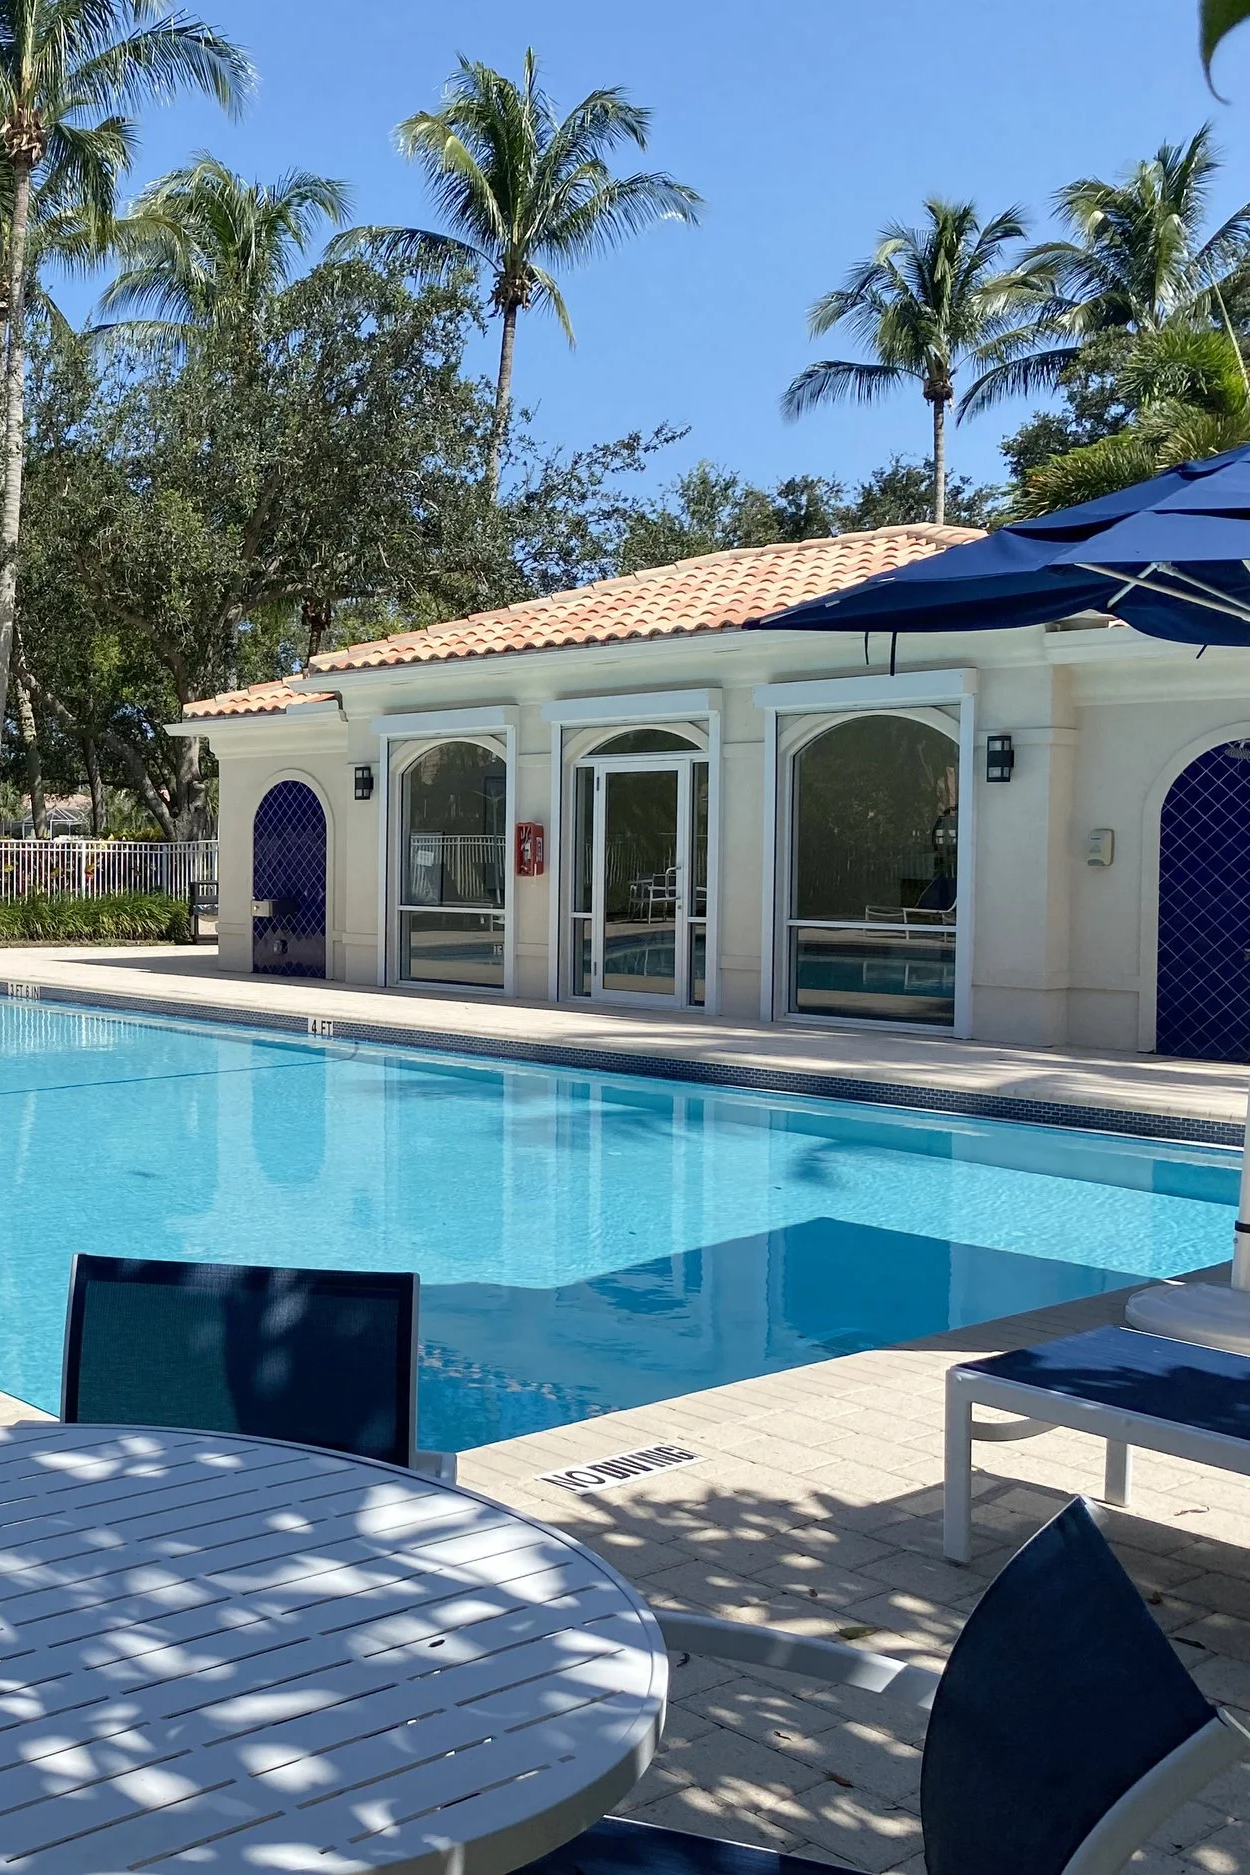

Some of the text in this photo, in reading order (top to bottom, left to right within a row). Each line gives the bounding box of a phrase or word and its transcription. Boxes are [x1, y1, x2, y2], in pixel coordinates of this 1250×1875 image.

[311, 1019, 332, 1036] 4 FT
[540, 1446, 696, 1492] NO DIVING
